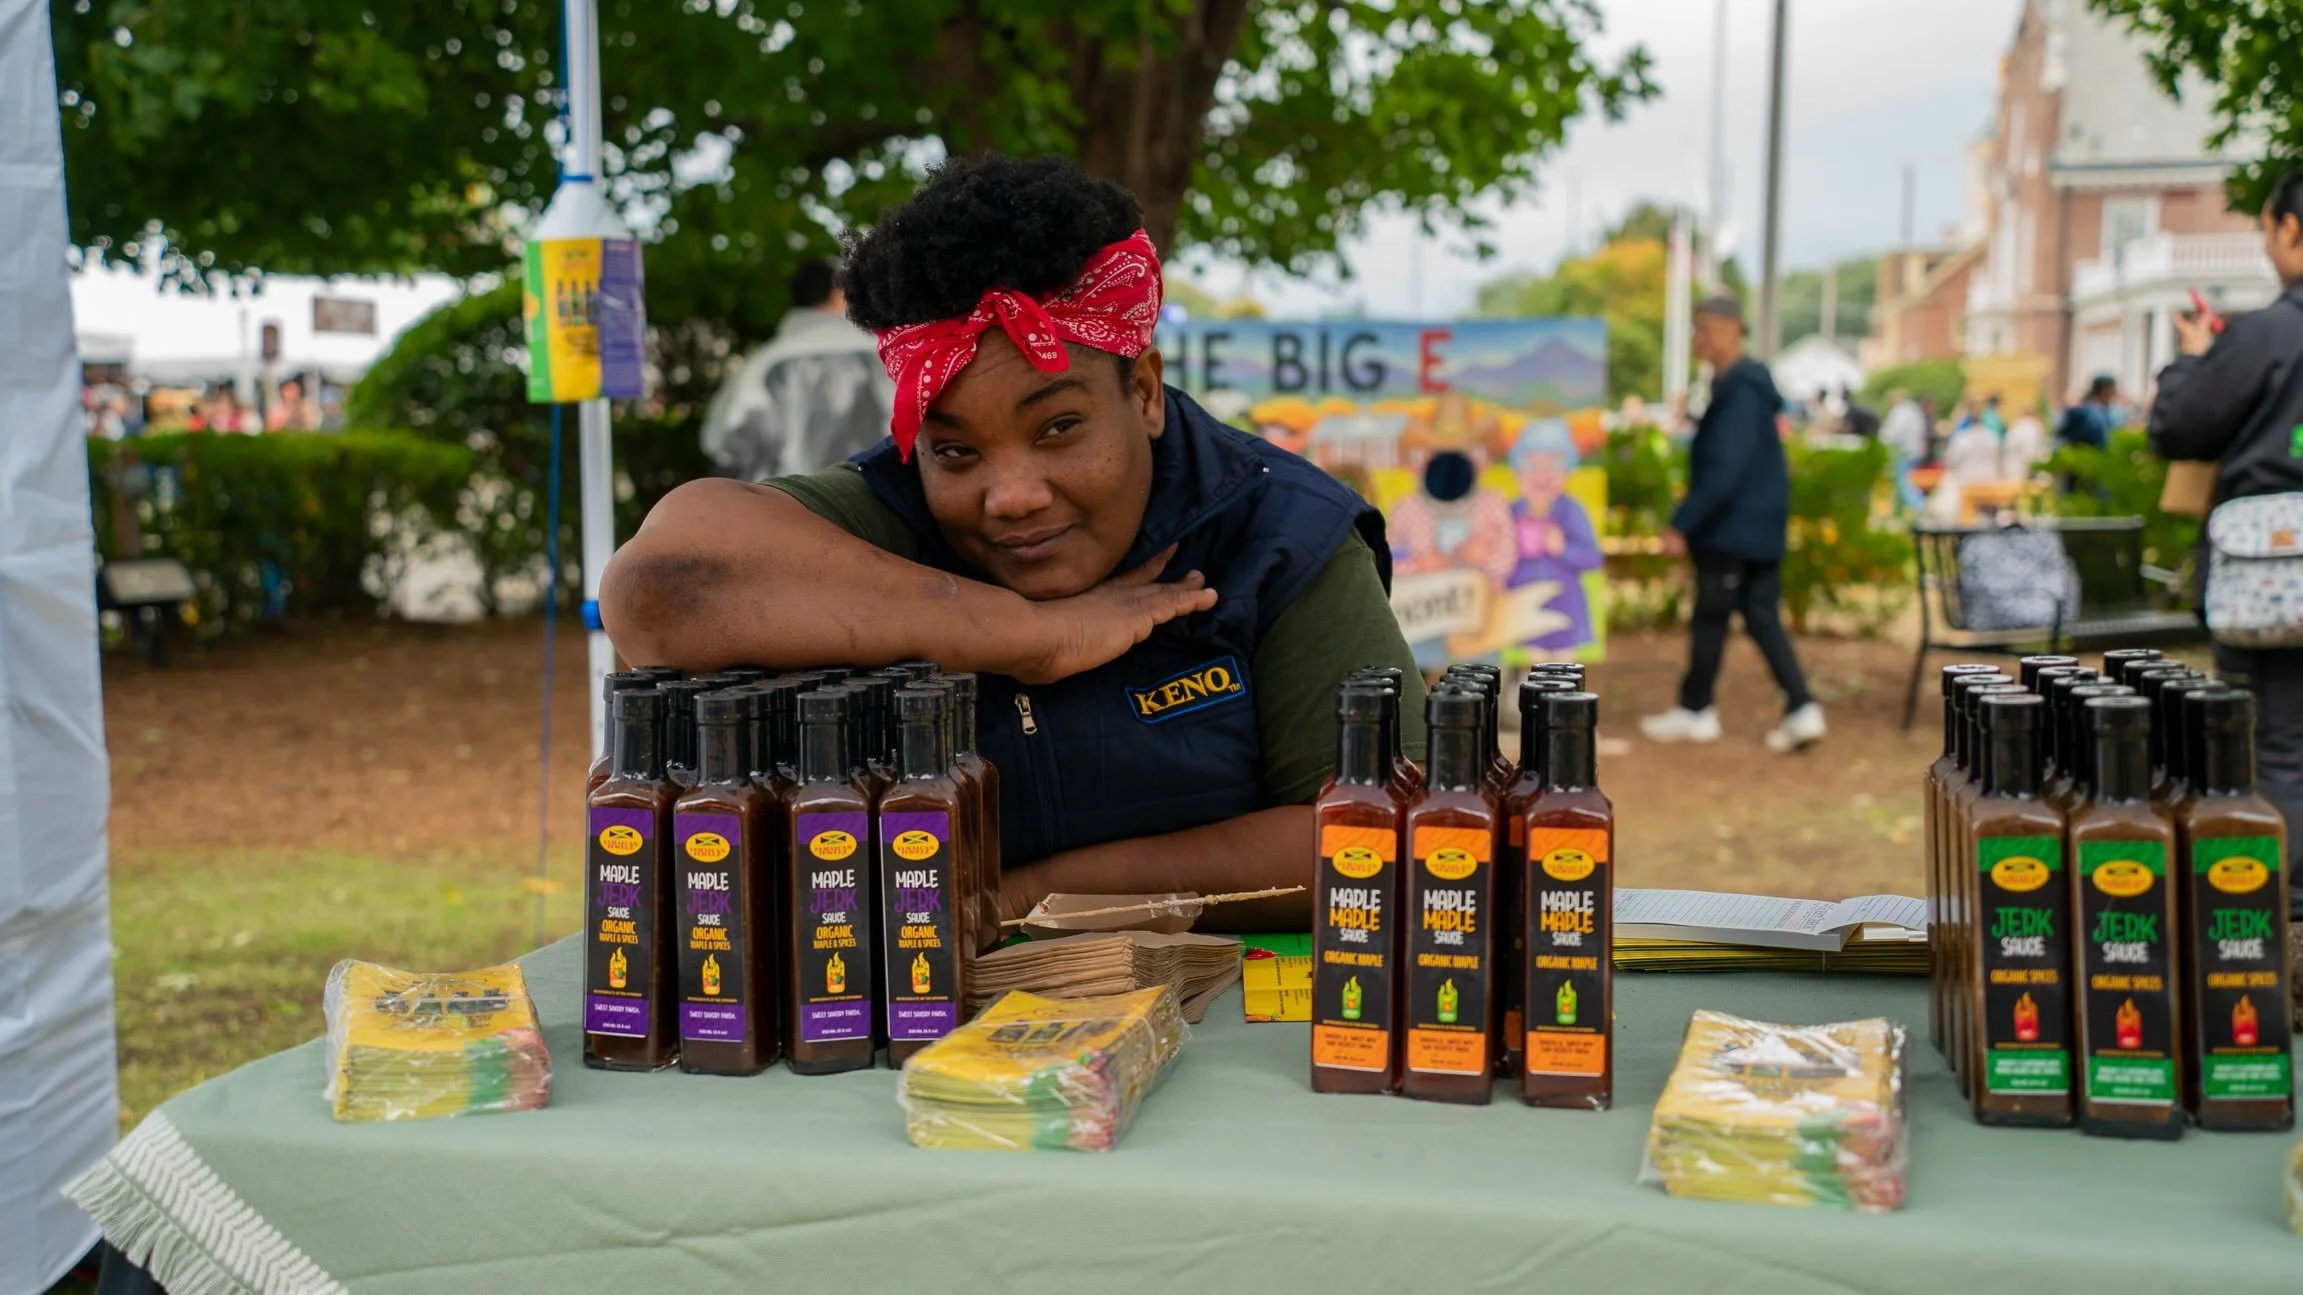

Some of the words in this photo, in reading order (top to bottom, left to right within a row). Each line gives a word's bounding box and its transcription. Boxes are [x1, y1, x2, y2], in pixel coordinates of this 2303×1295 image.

[1154, 329, 1233, 391] HE
[1272, 327, 1388, 393] BIG
[1418, 328, 1454, 394] E
[1135, 667, 1230, 714] KENO
[600, 864, 640, 884] MAPLE
[687, 872, 729, 890] MAPLE
[811, 869, 856, 889] MAPLE
[895, 869, 939, 888] MAPLE
[597, 883, 642, 907] JERK
[686, 890, 731, 915] JERK
[809, 888, 858, 914] JERK
[894, 887, 941, 912] JERK
[1329, 887, 1381, 910] MAPLE
[1423, 889, 1477, 912] MAPLE
[1541, 890, 1595, 913] MAPLE
[608, 906, 630, 918] SAUCE
[697, 913, 721, 925] SAUCE
[822, 911, 847, 924] SAUCE
[906, 912, 930, 923] SAUCE
[1329, 908, 1380, 931] MAPLE
[1423, 910, 1476, 933] MAPLE
[602, 920, 636, 934] ORGANIC
[816, 925, 853, 939] ORGANIC
[901, 925, 937, 939] ORGANIC
[1540, 911, 1594, 934] MAPLE
[1990, 907, 2054, 938] JERK
[2092, 911, 2158, 943] JERK
[2207, 908, 2273, 941] JERK
[599, 933, 617, 943] MAPLE
[622, 935, 638, 944] SPICES
[692, 927, 728, 940] ORGANIC
[898, 939, 917, 948] MAPLE
[922, 938, 941, 948] SPICES
[1339, 927, 1368, 943] SAUCE
[1433, 930, 1464, 945] SAUCE
[1552, 931, 1582, 946] SAUCE
[690, 940, 708, 949] MAPLE
[713, 941, 731, 950] SPICES
[813, 940, 832, 950] MAPLE
[838, 938, 857, 947] SPICES
[2001, 936, 2046, 957] SAUCE
[2102, 941, 2149, 964] SAUCE
[2218, 937, 2265, 960] SAUCE
[1323, 950, 1358, 965] ORGANIC
[1417, 953, 1452, 968] ORGANIC
[1536, 954, 1571, 969] ORGANIC
